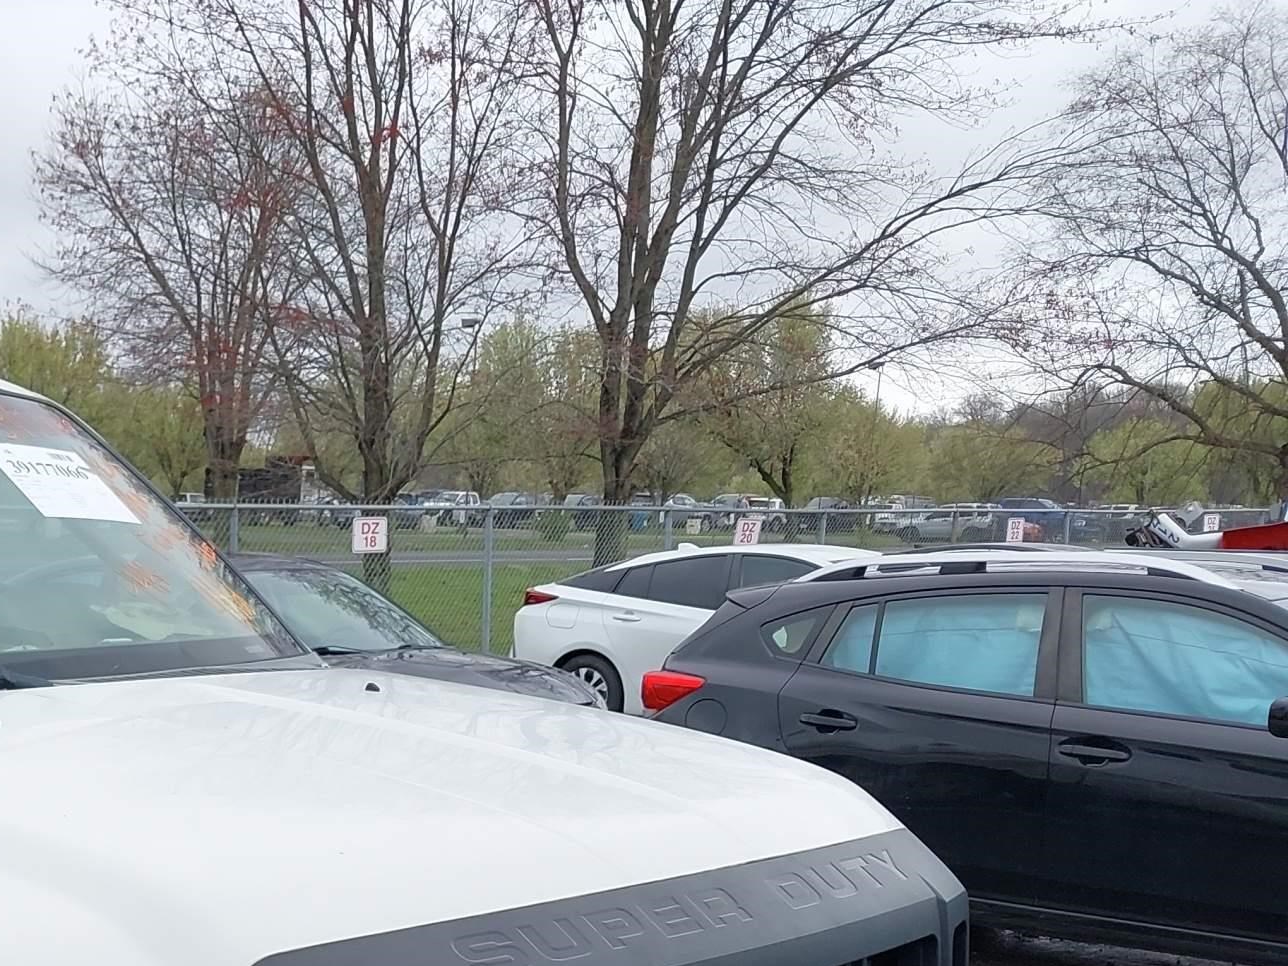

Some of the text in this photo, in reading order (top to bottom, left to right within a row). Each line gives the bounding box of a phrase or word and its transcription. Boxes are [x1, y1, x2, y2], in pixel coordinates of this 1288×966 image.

[6, 460, 90, 480] 39177066
[362, 522, 379, 534] DZ
[742, 522, 756, 532] DZ
[1012, 521, 1021, 529] DZ
[363, 536, 377, 547] 18
[740, 533, 753, 543] 20
[766, 848, 910, 911] DUTY
